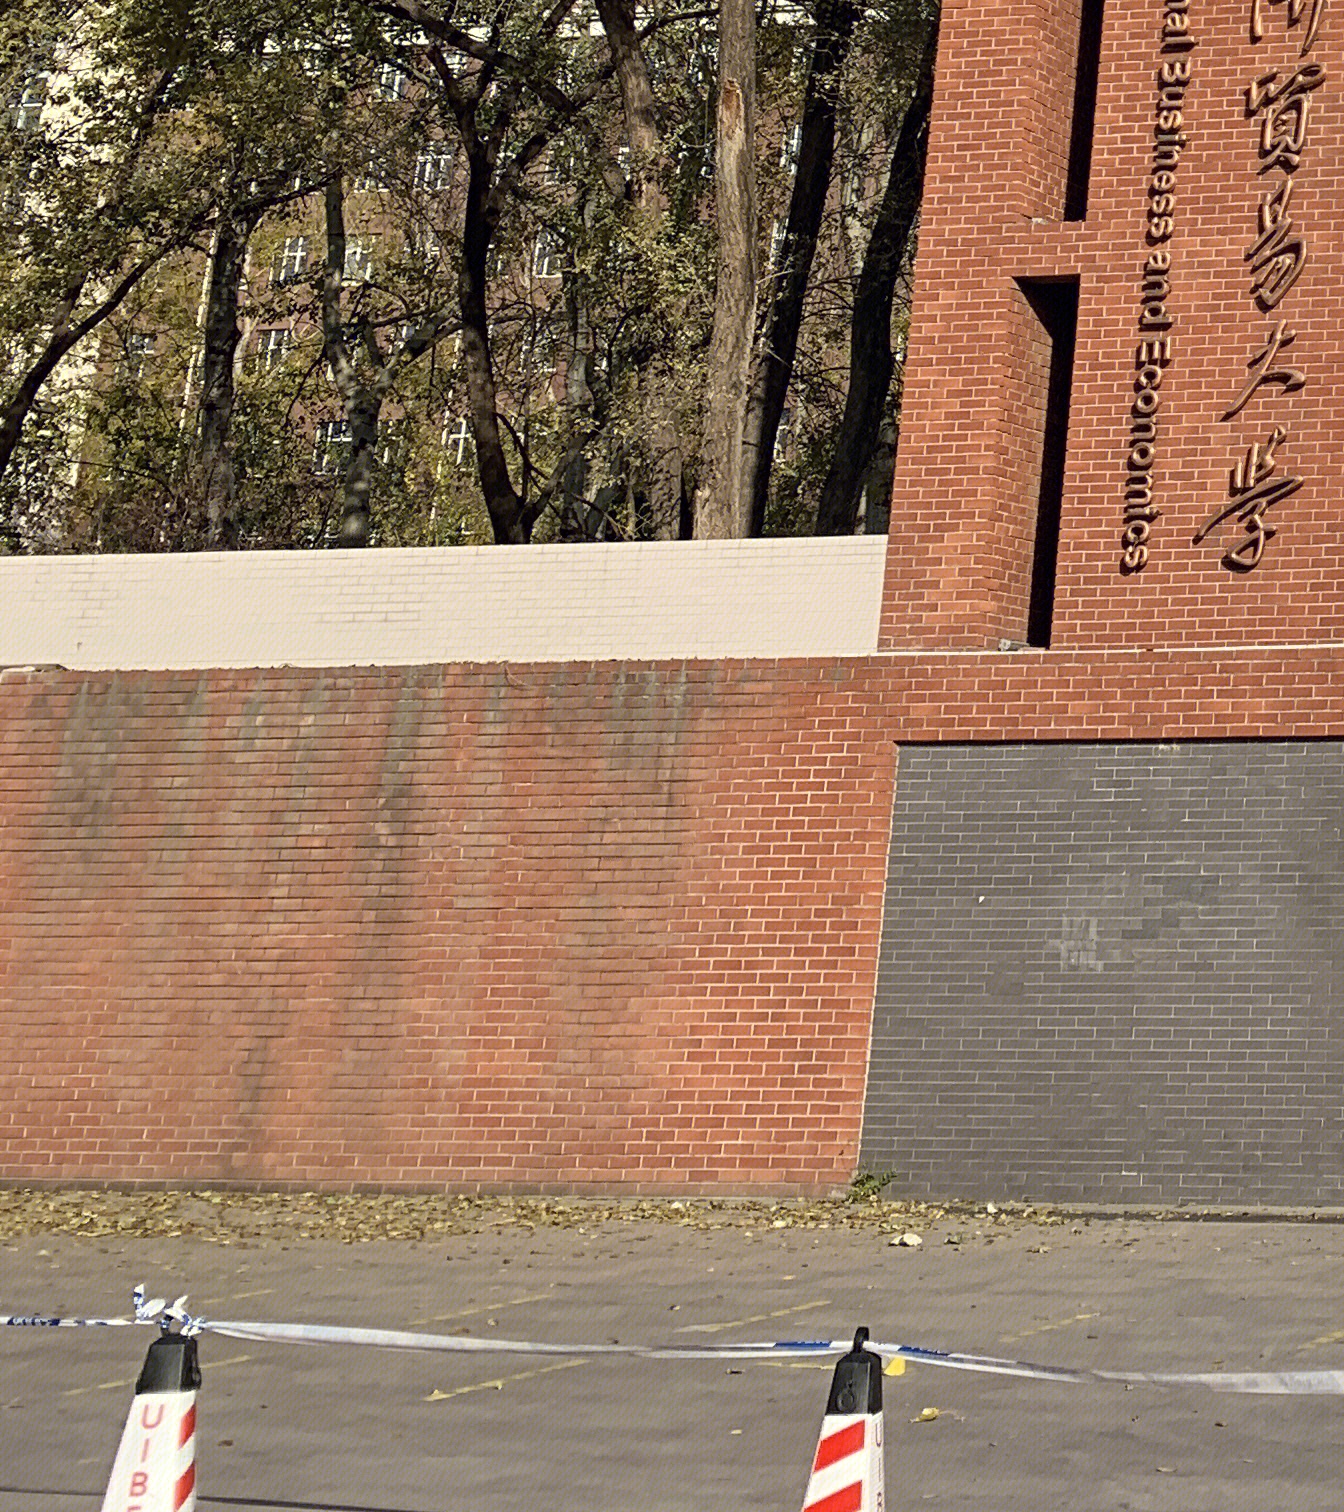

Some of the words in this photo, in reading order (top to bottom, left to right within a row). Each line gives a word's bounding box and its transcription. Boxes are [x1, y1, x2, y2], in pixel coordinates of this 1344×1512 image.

[1150, 56, 1192, 238] Business
[1140, 250, 1174, 325] and
[1123, 338, 1171, 571] Economics
[127, 1404, 164, 1512] UIB
